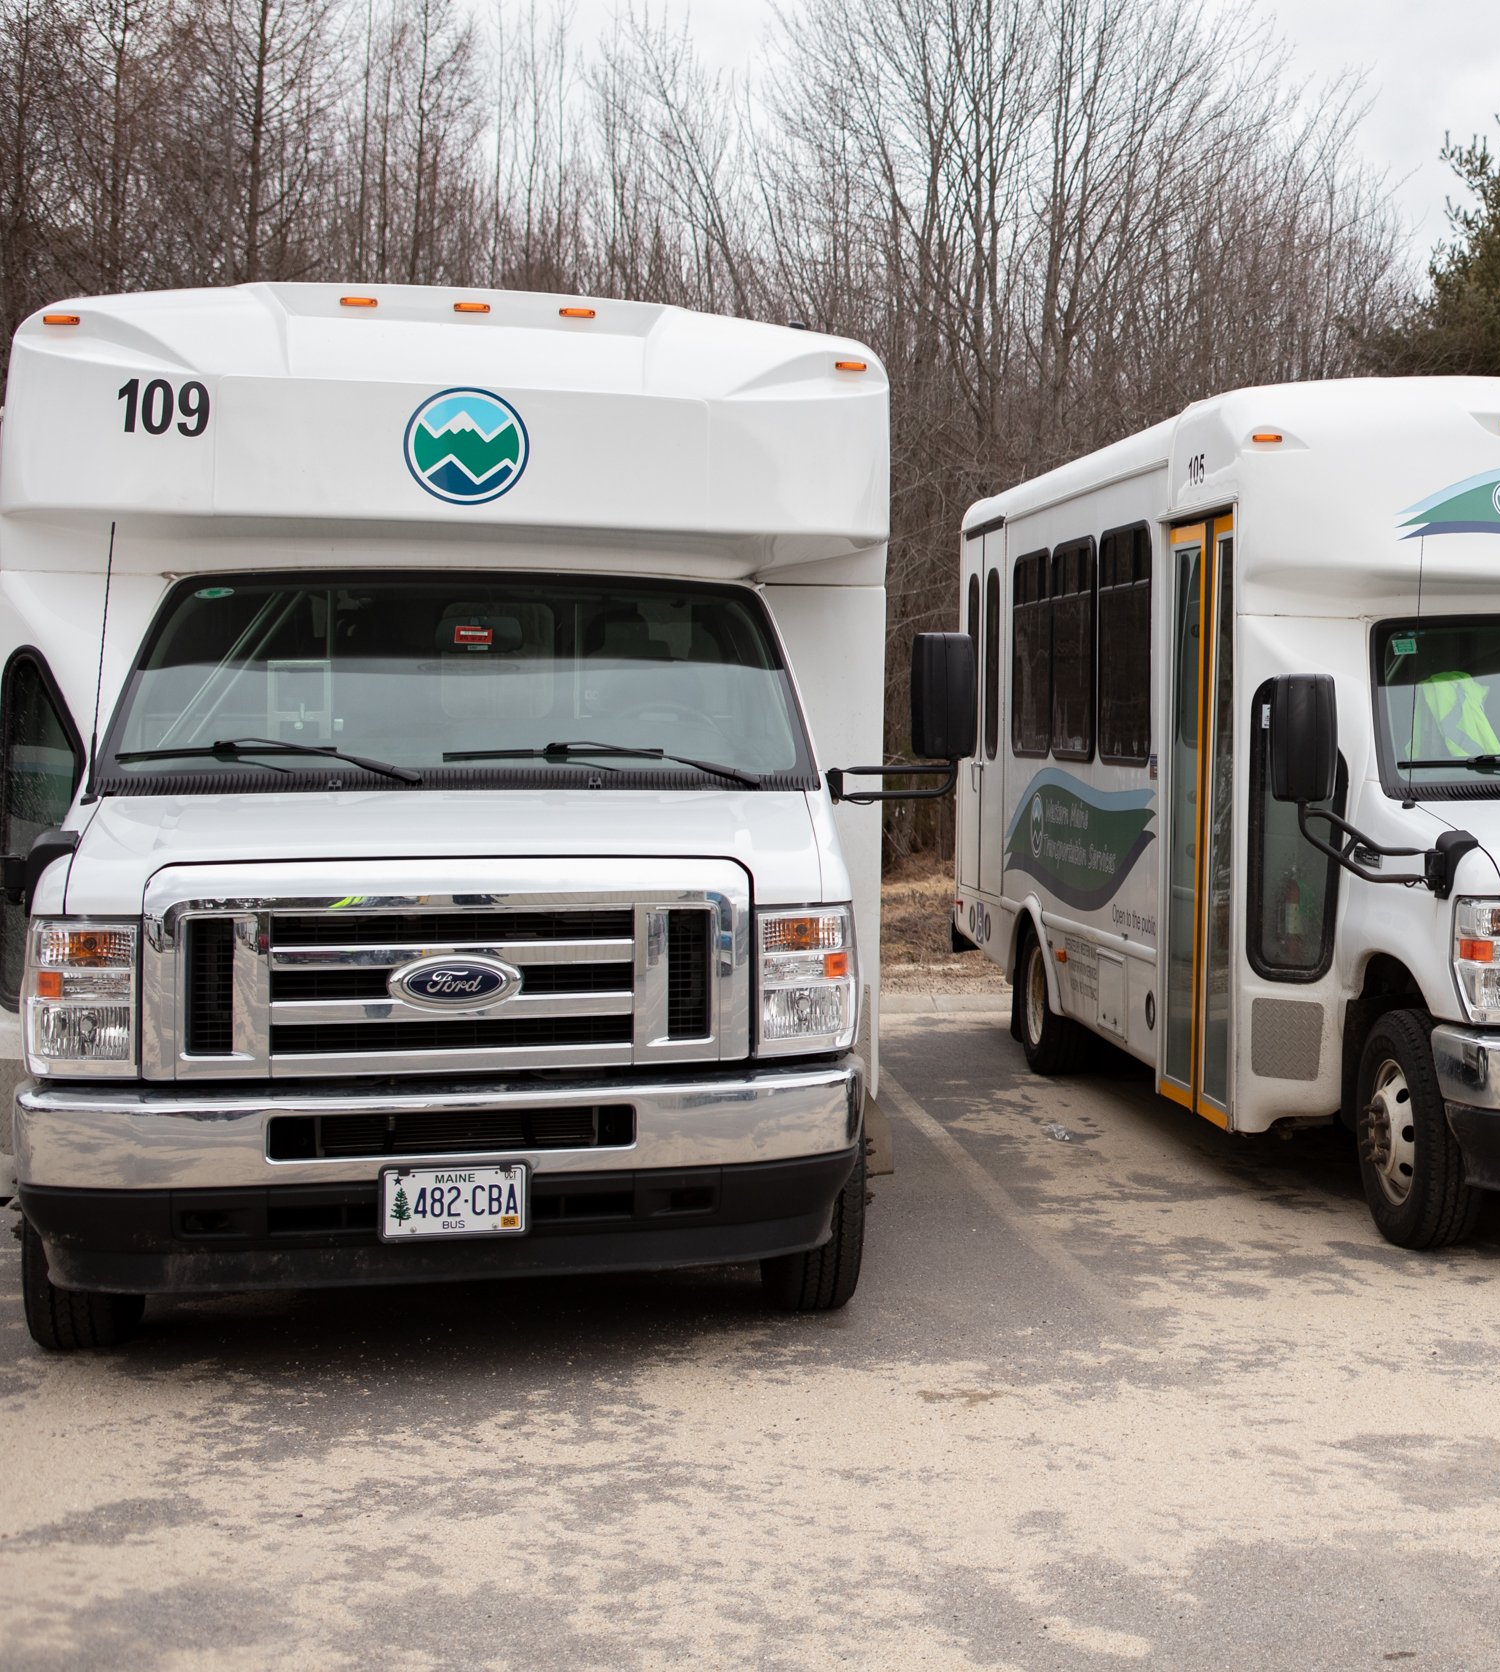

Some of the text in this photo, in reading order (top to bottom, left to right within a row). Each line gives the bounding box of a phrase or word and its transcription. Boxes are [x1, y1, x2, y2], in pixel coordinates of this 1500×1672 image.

[117, 378, 210, 437] 109
[1188, 454, 1205, 486] 105
[1112, 903, 1126, 928] Open
[1132, 910, 1141, 930] the
[1141, 913, 1157, 937] public
[426, 970, 483, 993] Ford
[434, 1173, 476, 1184] MAINE
[442, 1220, 466, 1230] BUS
[503, 1217, 516, 1226] 26
